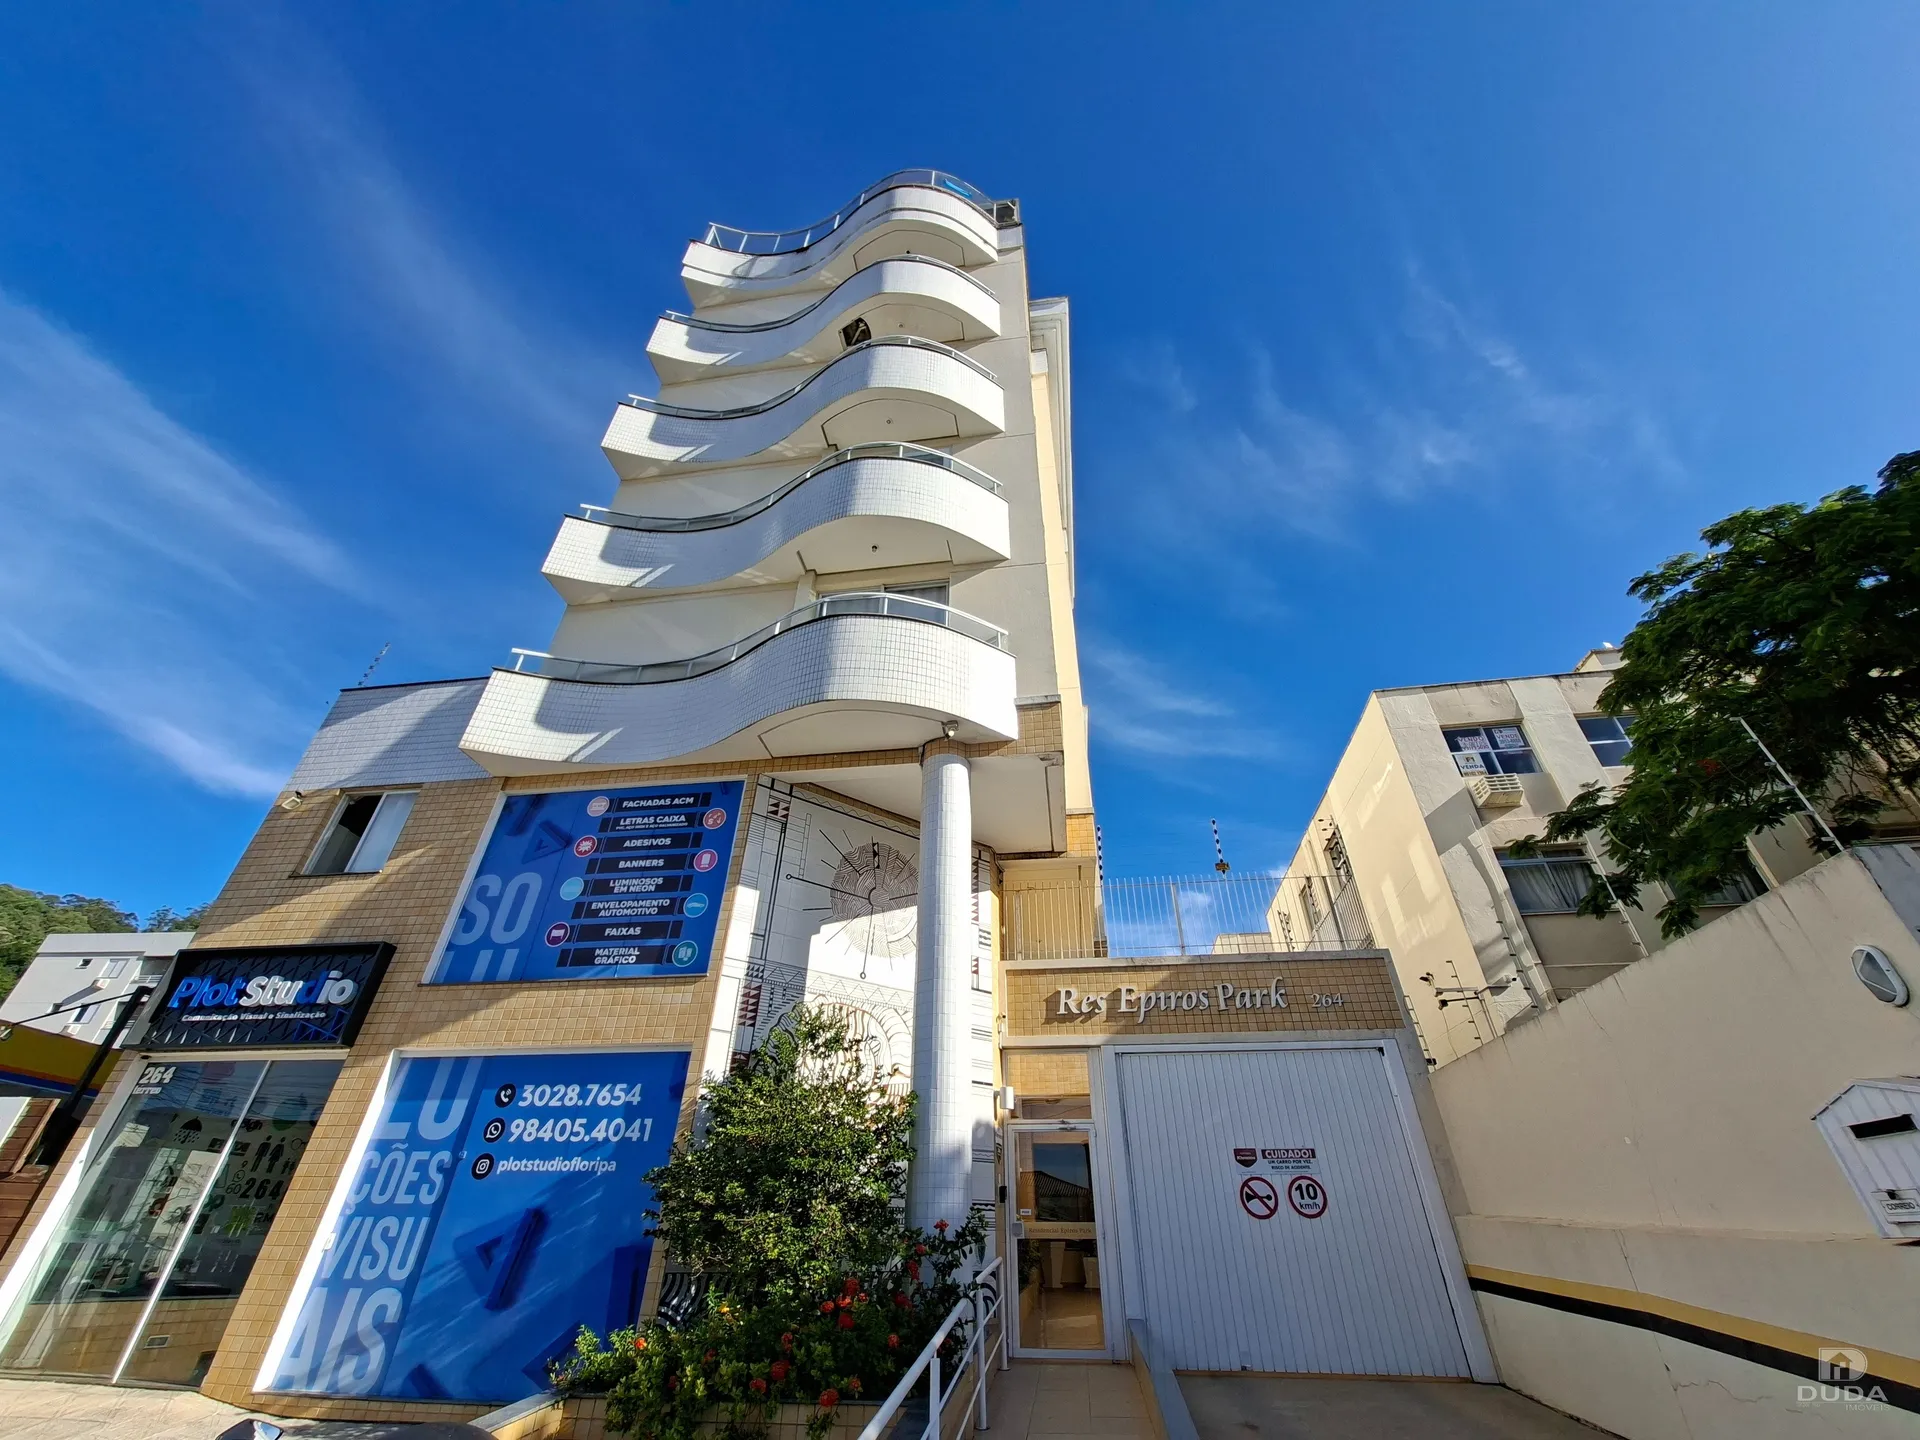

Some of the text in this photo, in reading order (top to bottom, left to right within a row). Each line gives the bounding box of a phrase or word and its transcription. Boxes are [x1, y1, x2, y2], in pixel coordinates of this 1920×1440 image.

[622, 797, 694, 808] FACHADAS ACM
[620, 814, 686, 826] LETRAS CAIXA
[623, 838, 672, 848] ADESIVOS
[618, 859, 664, 868] BANNERS
[610, 878, 664, 887] LUMINOSOS
[450, 872, 543, 946] SO
[591, 899, 670, 910] ENVELOPAMENTO
[598, 908, 658, 917] AUTOMOTIVO
[604, 927, 642, 936] FAIXAS
[594, 947, 640, 956] MATERIAL
[594, 955, 637, 965] GRÁFICO
[167, 970, 360, 1010] PlotStudio
[1056, 976, 1344, 1024] Res Epiros Park 264
[138, 1066, 177, 1084] 264
[518, 1083, 642, 1107] 3028.7654
[508, 1117, 653, 1143] 98405.4041
[1265, 1149, 1312, 1159] CUIDADO!
[496, 1156, 616, 1175] plotstudiofloripa
[345, 1142, 453, 1214] ÇÕES
[238, 1177, 284, 1200] 264
[1294, 1183, 1318, 1200] 10
[1299, 1202, 1320, 1210] km/h
[321, 1216, 430, 1281] VISU
[271, 1287, 403, 1394] AIS
